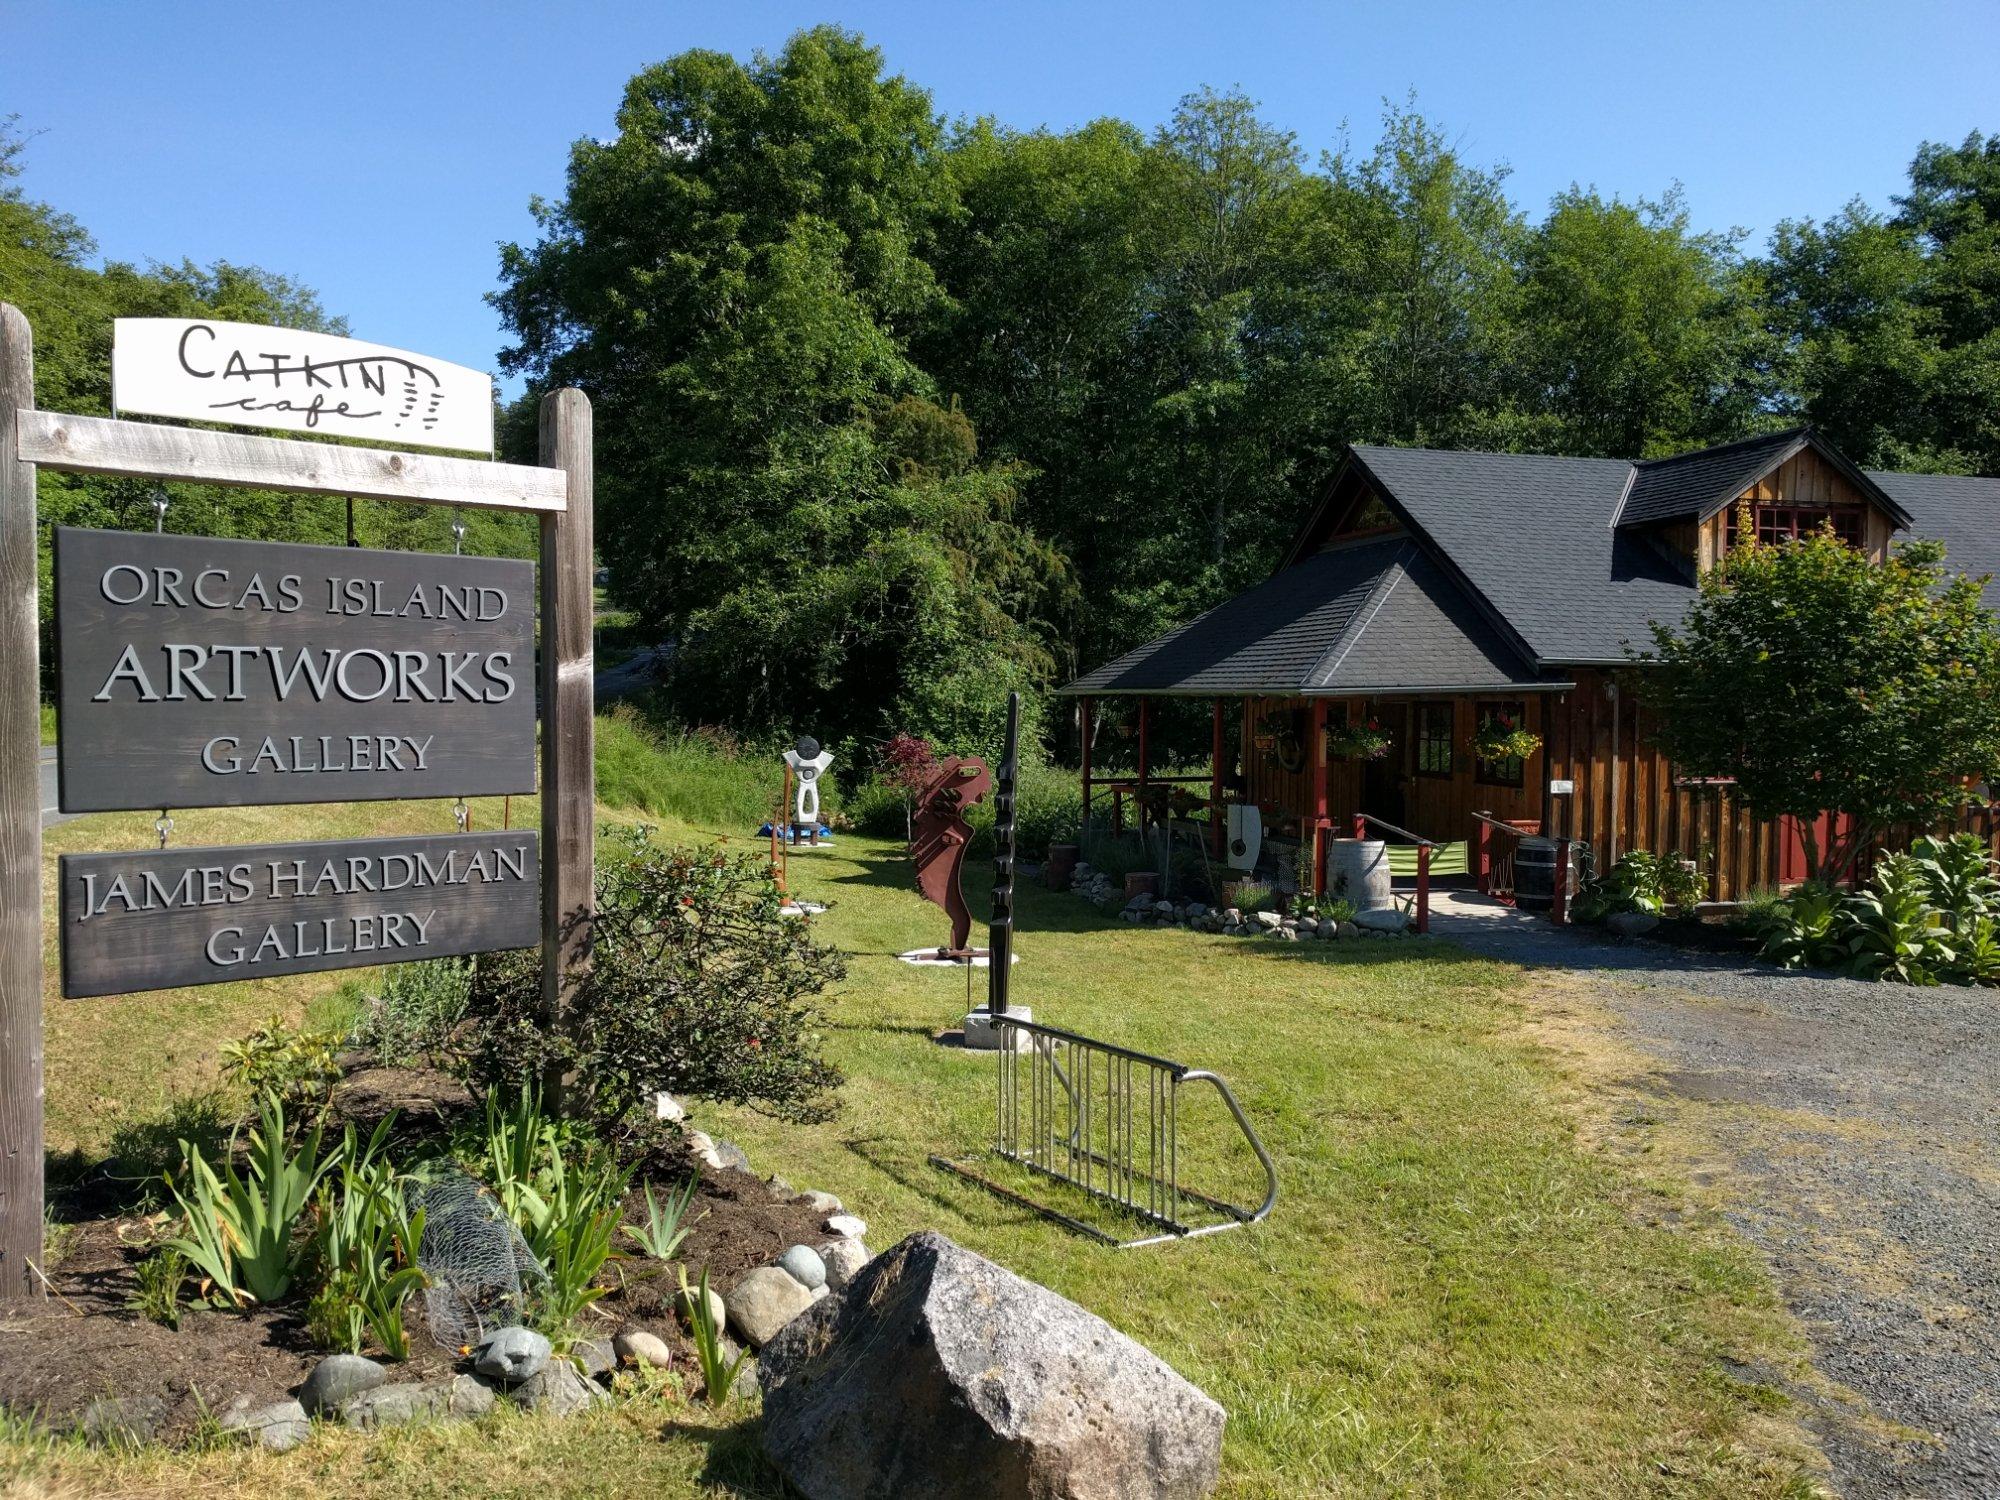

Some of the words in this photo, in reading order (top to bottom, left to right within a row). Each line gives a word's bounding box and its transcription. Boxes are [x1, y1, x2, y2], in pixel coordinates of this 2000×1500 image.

[179, 325, 385, 394] CATKIN
[208, 395, 382, 426] cafe
[101, 564, 304, 613] ORCAS
[327, 577, 509, 621] ISLAND
[93, 644, 516, 703] ARTWORKS
[202, 735, 434, 774] GALLERY
[80, 863, 255, 921] JAMES
[269, 847, 527, 899] HARDMAN
[207, 910, 436, 966] GALLERY
